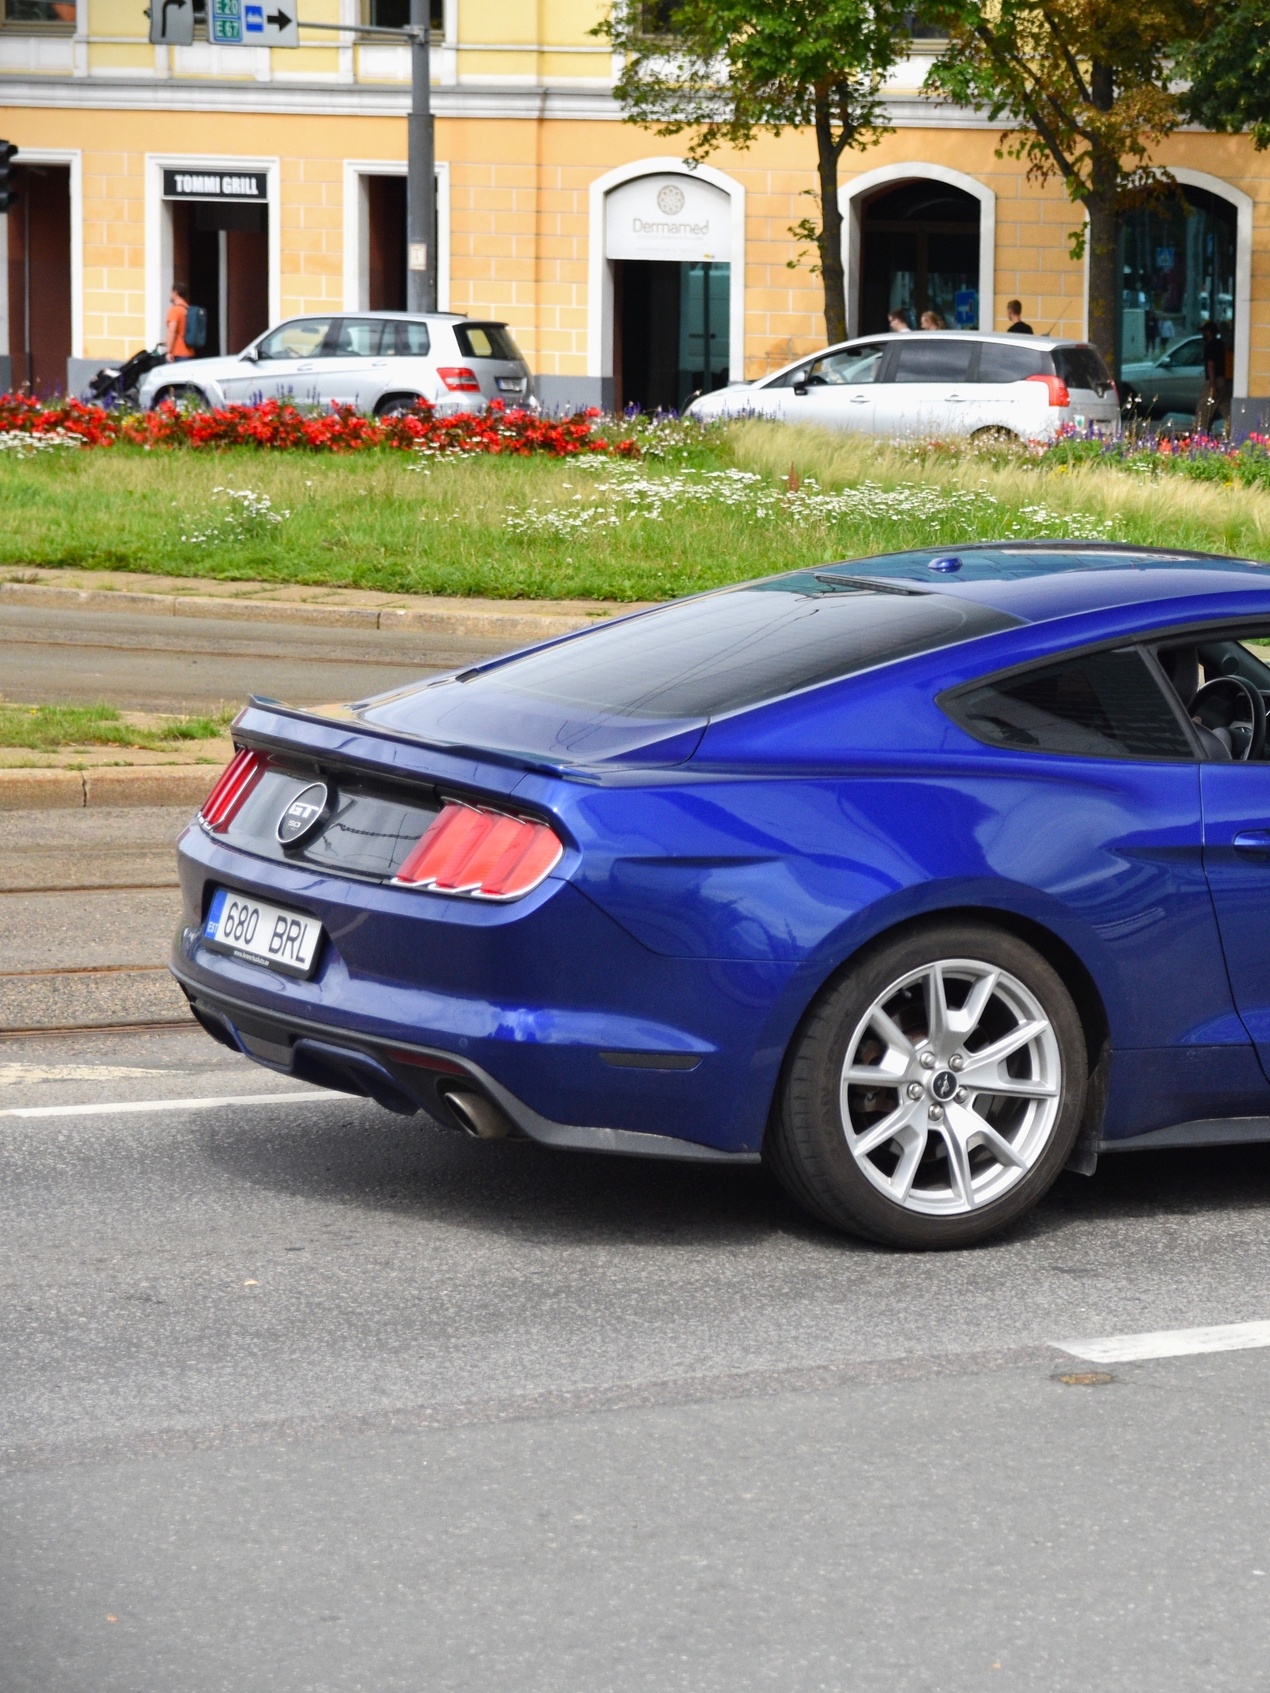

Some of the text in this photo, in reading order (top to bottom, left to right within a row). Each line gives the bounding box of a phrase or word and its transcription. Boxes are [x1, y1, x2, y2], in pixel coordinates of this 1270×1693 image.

[215, 0, 238, 14] E 20
[216, 21, 239, 37] E 67
[174, 174, 259, 195] TOMMI GRILL
[633, 217, 709, 235] Dermamed
[288, 802, 319, 817] GT
[206, 921, 219, 934] EST
[223, 901, 308, 964] 680 BRL
